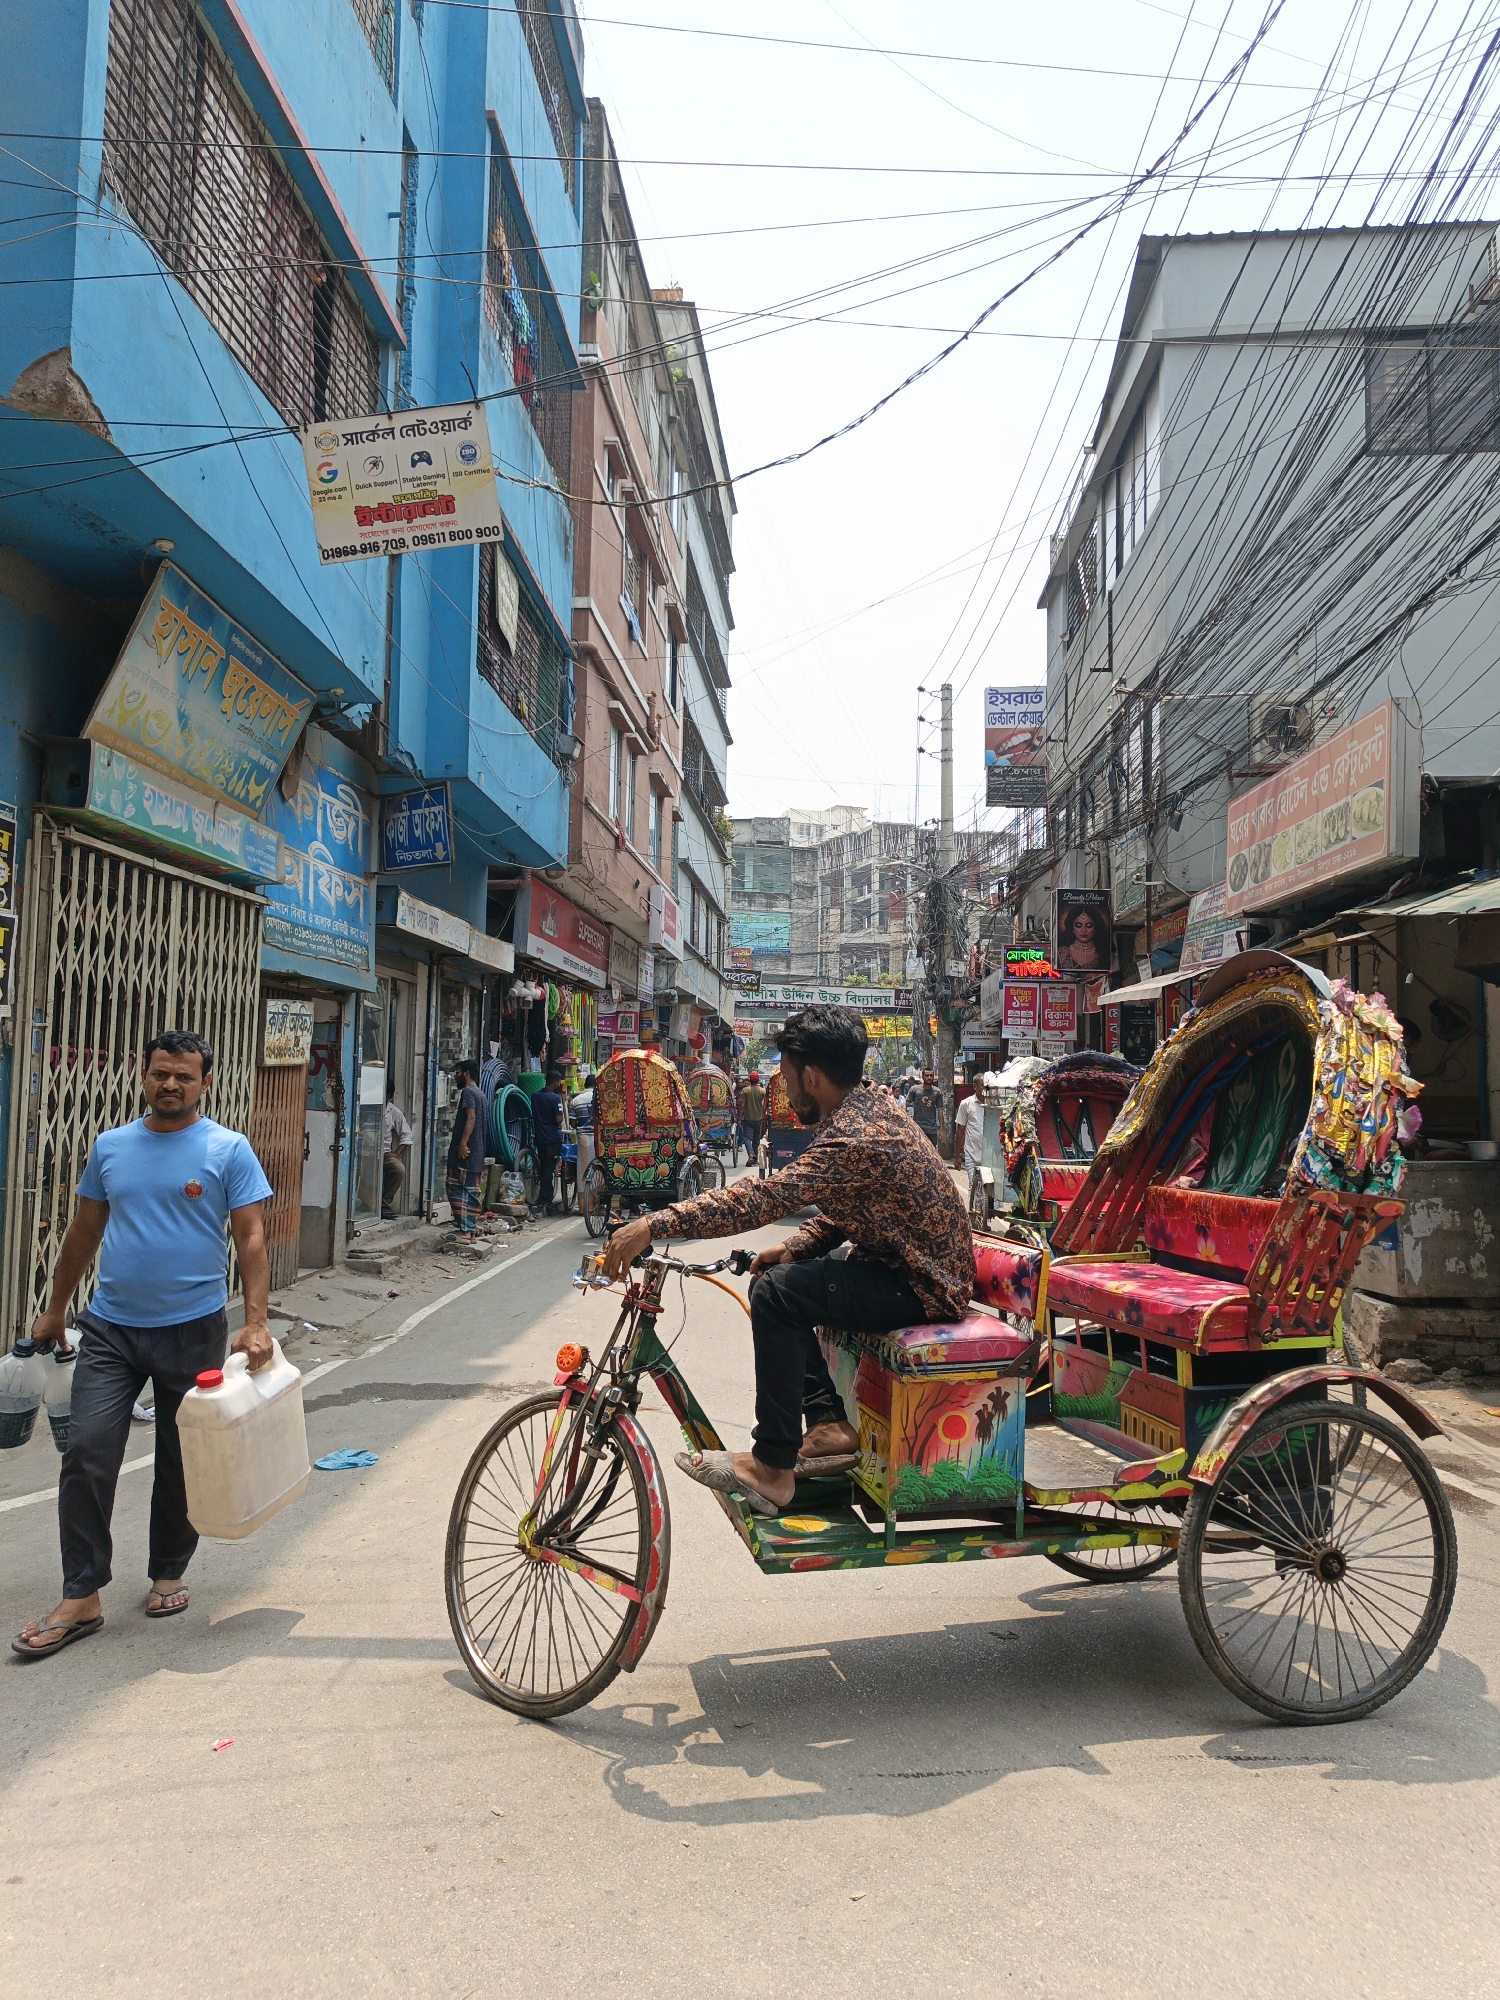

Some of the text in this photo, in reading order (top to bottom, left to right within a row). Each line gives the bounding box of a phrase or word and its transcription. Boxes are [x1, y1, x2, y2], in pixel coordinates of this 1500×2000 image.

[341, 410, 473, 447] সার্কেল নেটওয়ার্ক
[402, 473, 446, 484] Stable Gaming
[464, 468, 491, 476] Certified
[312, 485, 348, 497] Google.com
[355, 478, 399, 491] Quick Support
[412, 481, 438, 489] Latency
[353, 494, 456, 527] ইন্টারনেট
[406, 522, 438, 533] যোগাযোগ
[321, 525, 500, 560] 01969 916 709, 09611 800 900
[152, 596, 226, 694] হাসান
[221, 654, 310, 748] জুয়েলার্স
[988, 688, 1044, 707] ইসরাত
[988, 708, 1045, 727] ডেন্টাল কেয়ার
[1229, 811, 1251, 845] ঘরের
[1251, 796, 1275, 833] খাবার
[1276, 775, 1310, 821] হোটেল
[1332, 721, 1386, 788] রেস্টুরেন্ট
[141, 780, 189, 833] হাসান
[286, 779, 370, 860] কাজী
[386, 793, 446, 849] কাজী অফিস
[395, 848, 434, 863] নিচতলা
[1062, 892, 1085, 902] Beauty
[308, 913, 314, 923] ও
[578, 920, 605, 953] SUPERSTAR
[1006, 949, 1045, 962] মোবাইল
[818, 988, 843, 1003] উচ্চ
[845, 991, 893, 1006] বিদ্যালয়
[1044, 1008, 1074, 1020] বিকাশ
[1052, 1002, 1069, 1011] বিল
[268, 1003, 290, 1038] কাজী
[1048, 1020, 1069, 1028] করুন
